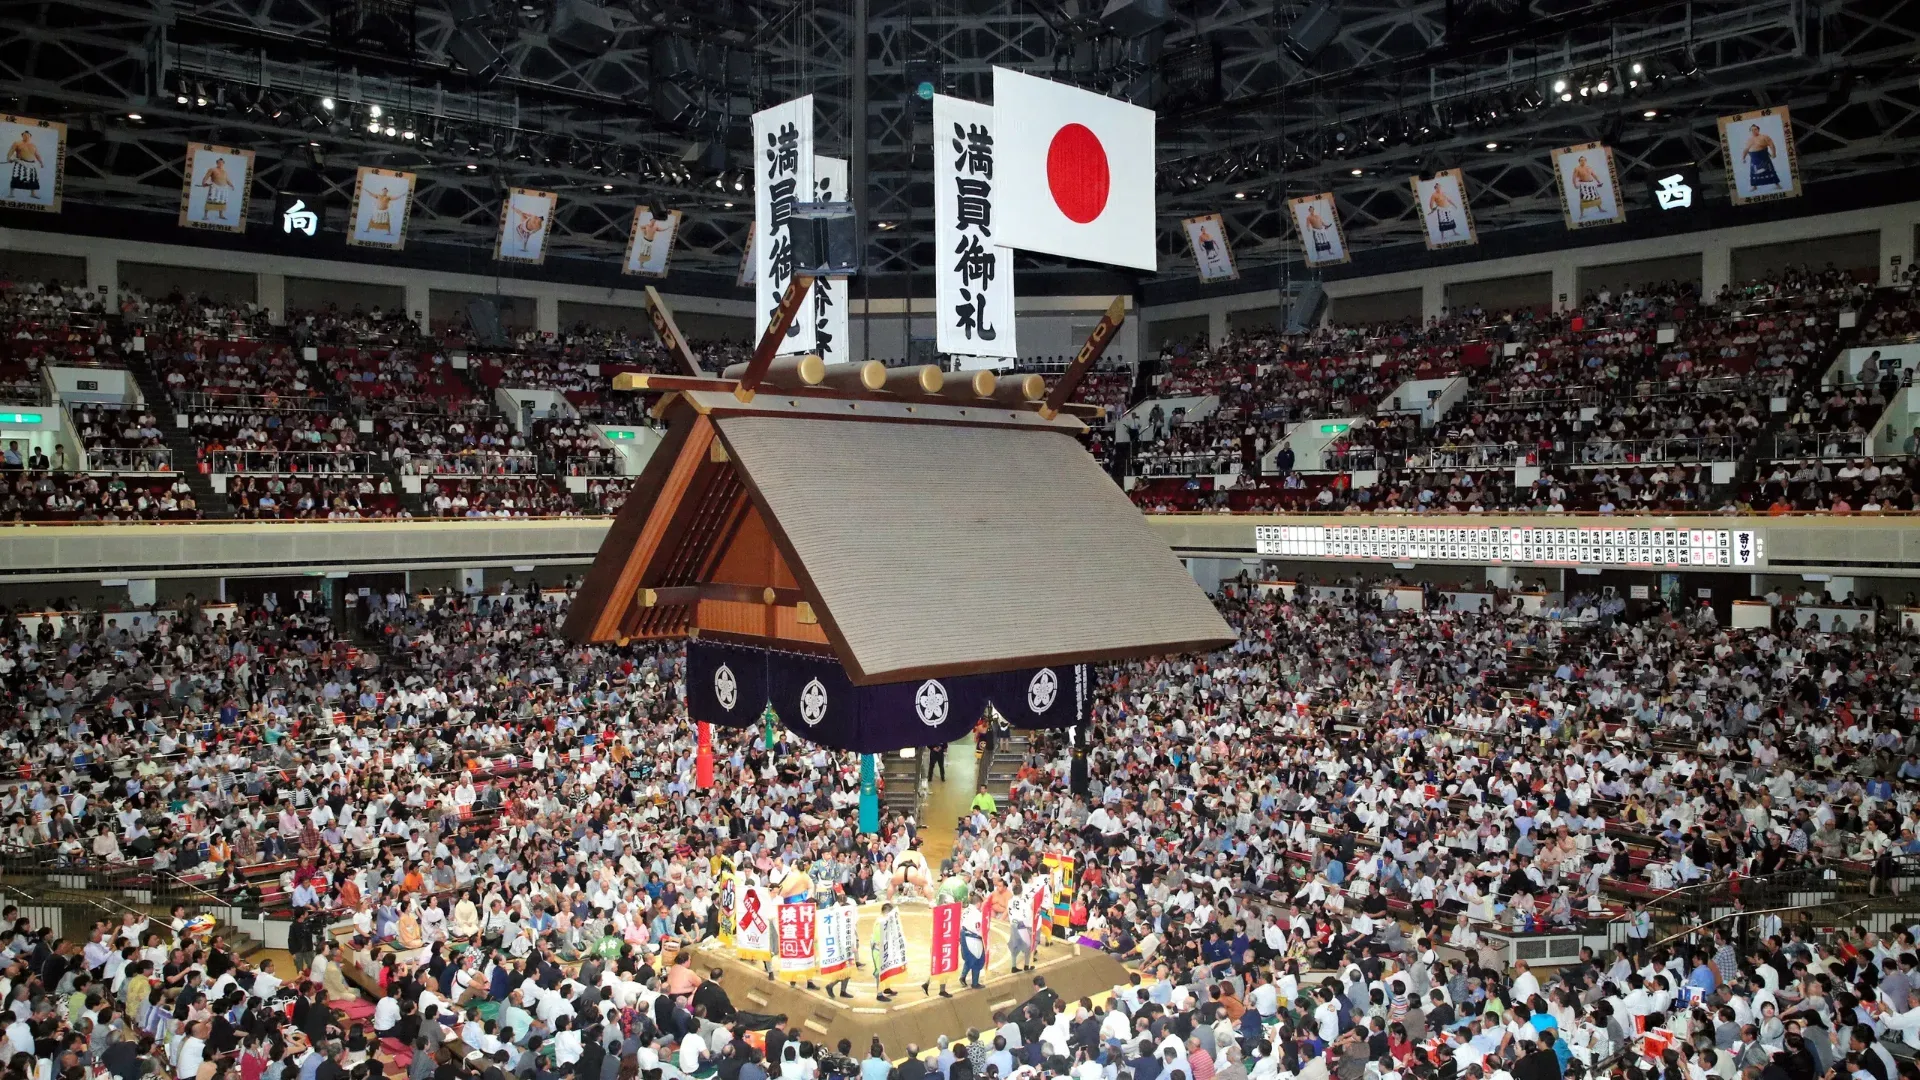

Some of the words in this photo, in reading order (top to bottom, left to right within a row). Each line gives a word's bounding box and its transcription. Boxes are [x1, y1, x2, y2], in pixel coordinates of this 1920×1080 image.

[1655, 173, 1693, 210] 西
[283, 199, 318, 236] 向
[952, 121, 997, 341] 満員御礼
[1738, 532, 1750, 563] 寄り切り
[781, 906, 797, 939] 検査
[799, 905, 814, 956] HIV
[823, 914, 836, 958] オーロラ
[941, 908, 953, 972] クリニック
